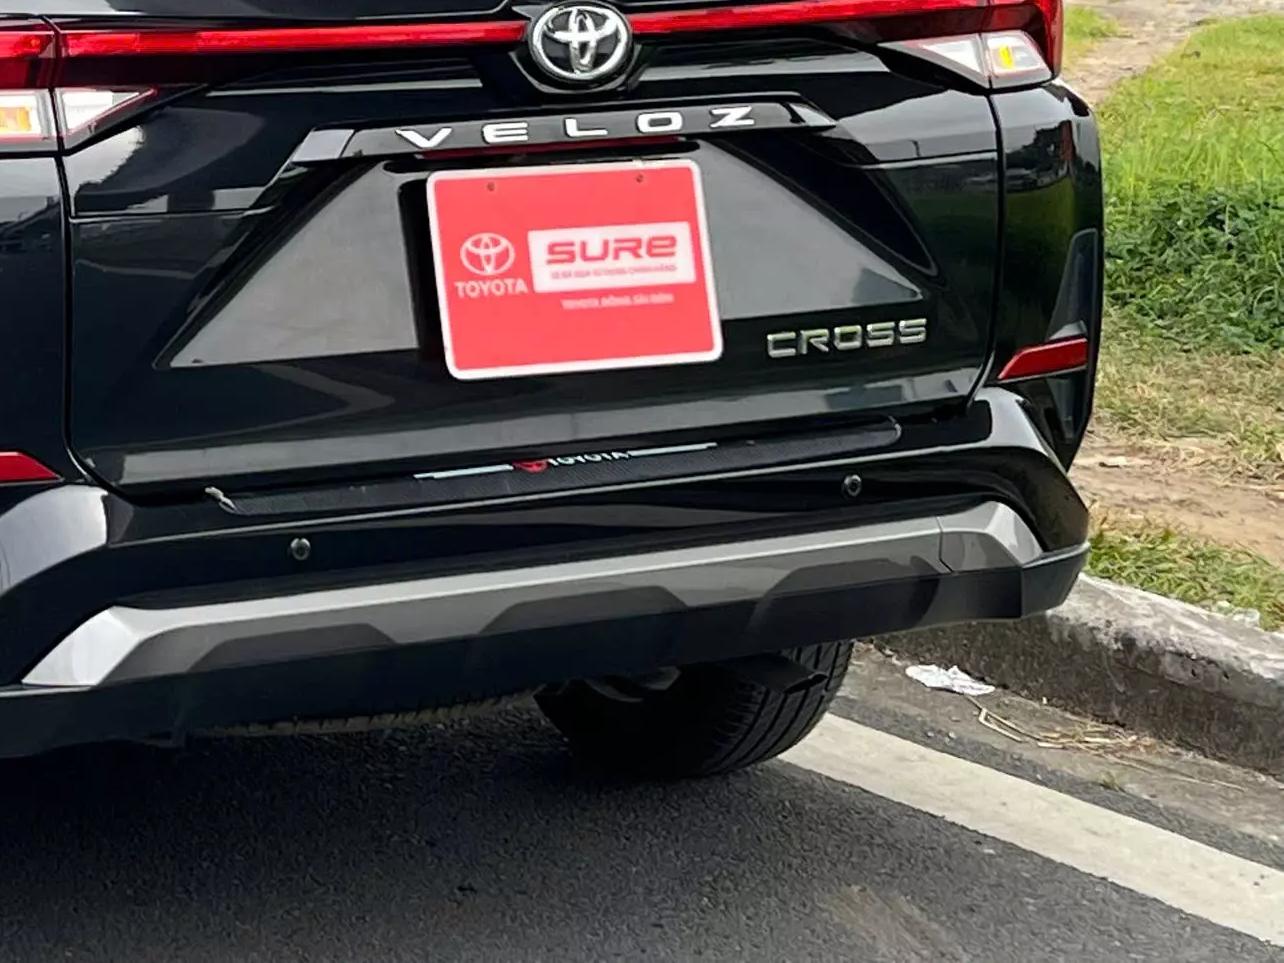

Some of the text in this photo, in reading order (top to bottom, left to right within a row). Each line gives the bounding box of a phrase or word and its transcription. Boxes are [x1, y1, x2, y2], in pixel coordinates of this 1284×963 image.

[396, 106, 756, 148] VELOZ
[454, 277, 529, 299] TOYOTA
[767, 318, 927, 358] CROSS
